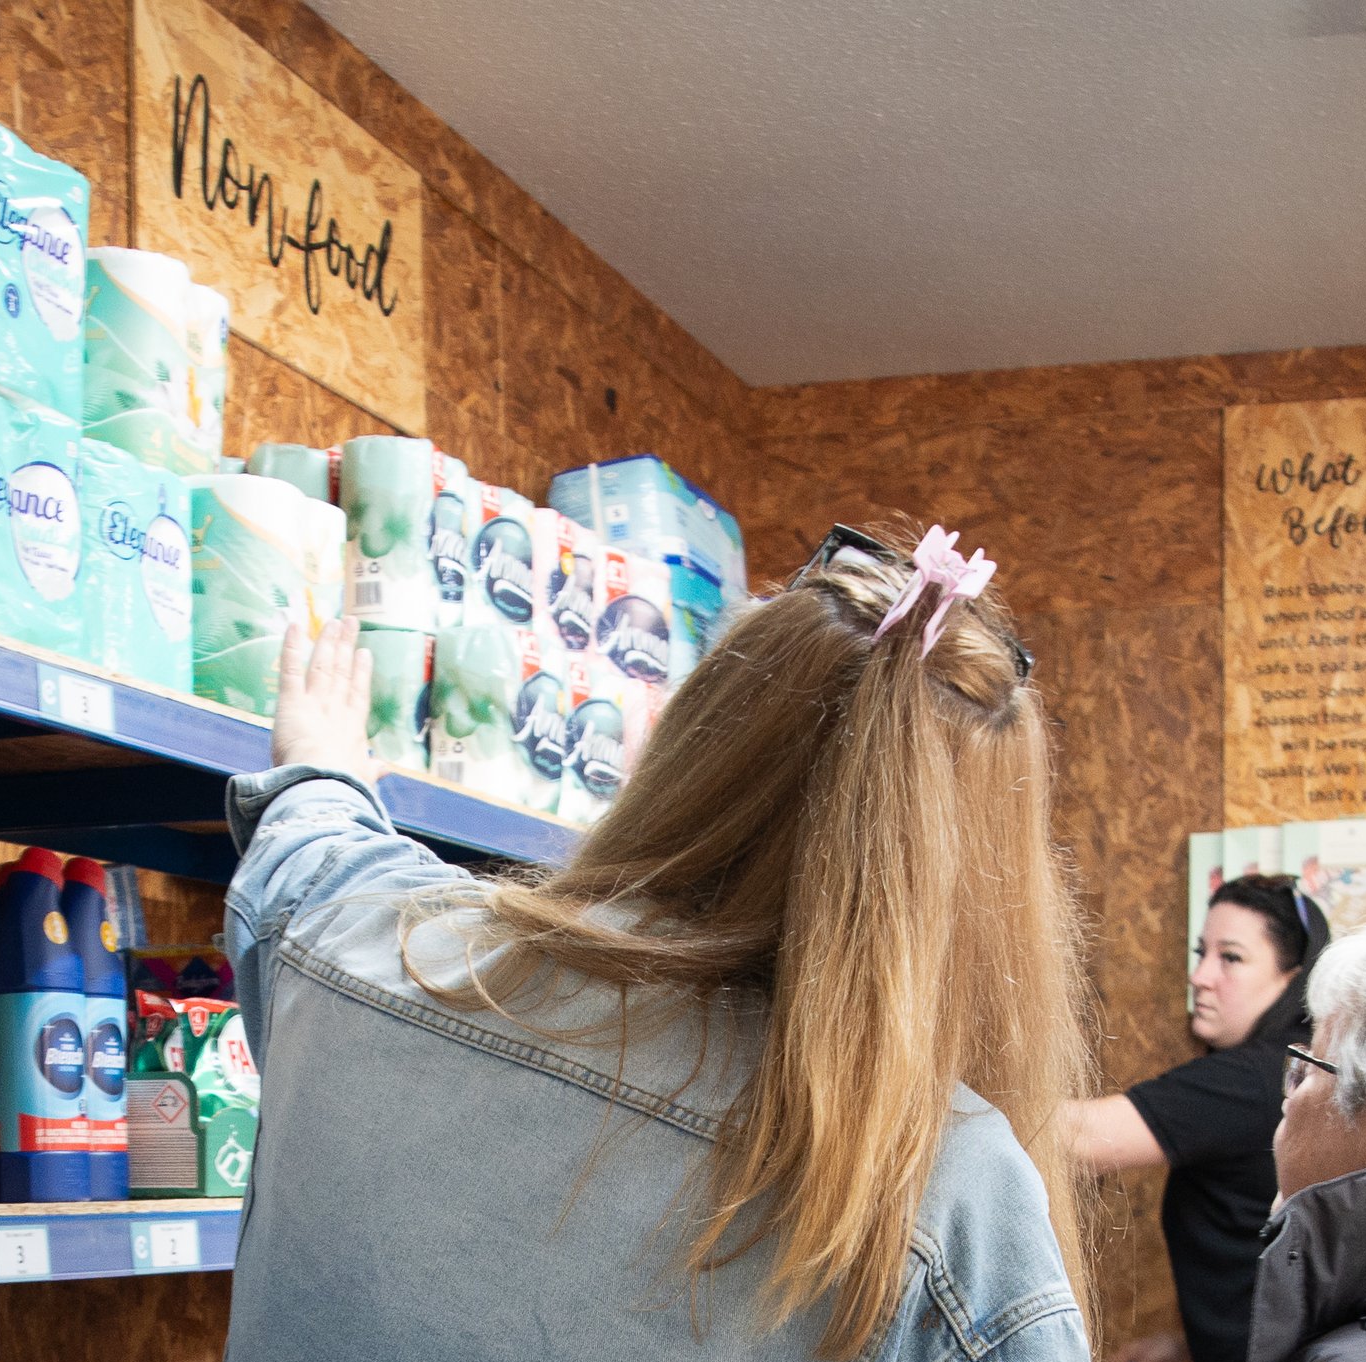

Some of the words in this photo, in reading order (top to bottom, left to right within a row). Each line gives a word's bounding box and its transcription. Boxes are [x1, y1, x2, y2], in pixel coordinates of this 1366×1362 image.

[172, 74, 287, 268] Non
[287, 178, 398, 317] food
[1256, 452, 1360, 494] What
[108, 511, 180, 570] Elegance
[16, 1243, 26, 1265] 3
